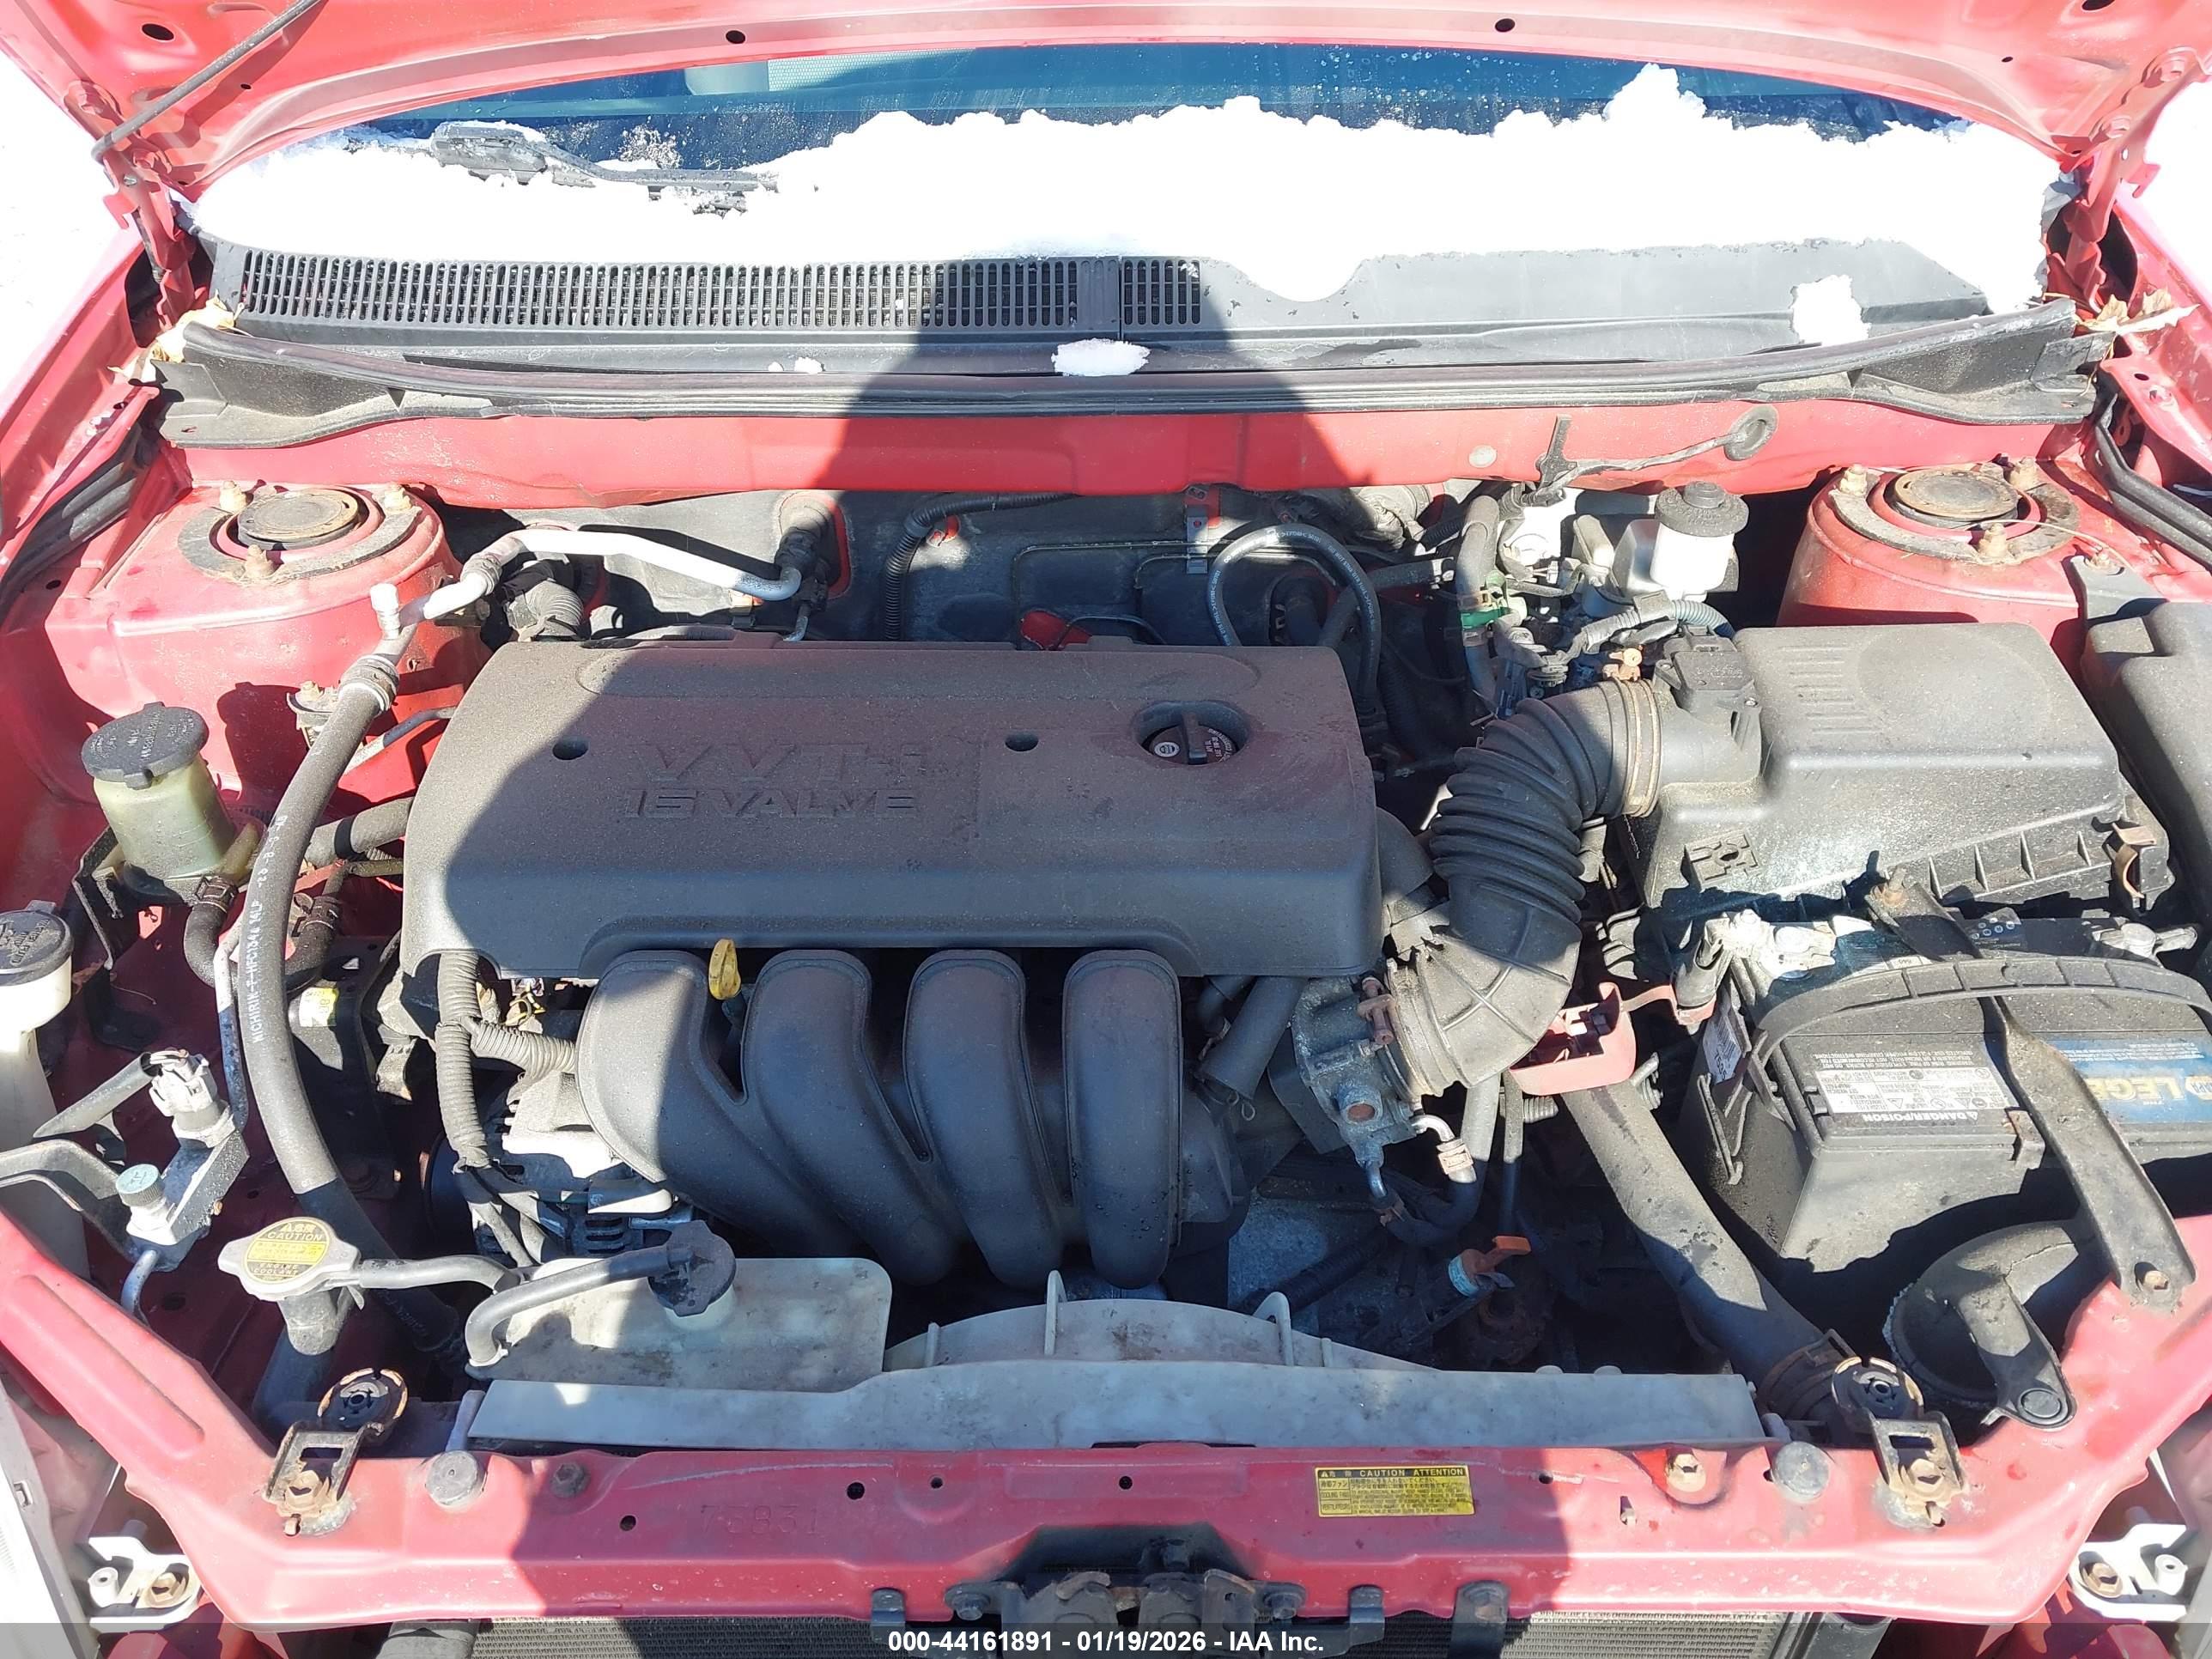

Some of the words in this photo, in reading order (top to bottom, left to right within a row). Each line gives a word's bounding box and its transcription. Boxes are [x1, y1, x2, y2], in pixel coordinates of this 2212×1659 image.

[1862, 1112, 1966, 1121] DANGER/POISON
[267, 1232, 323, 1242] CAUTION
[1413, 1468, 1464, 1477] ATTENTION
